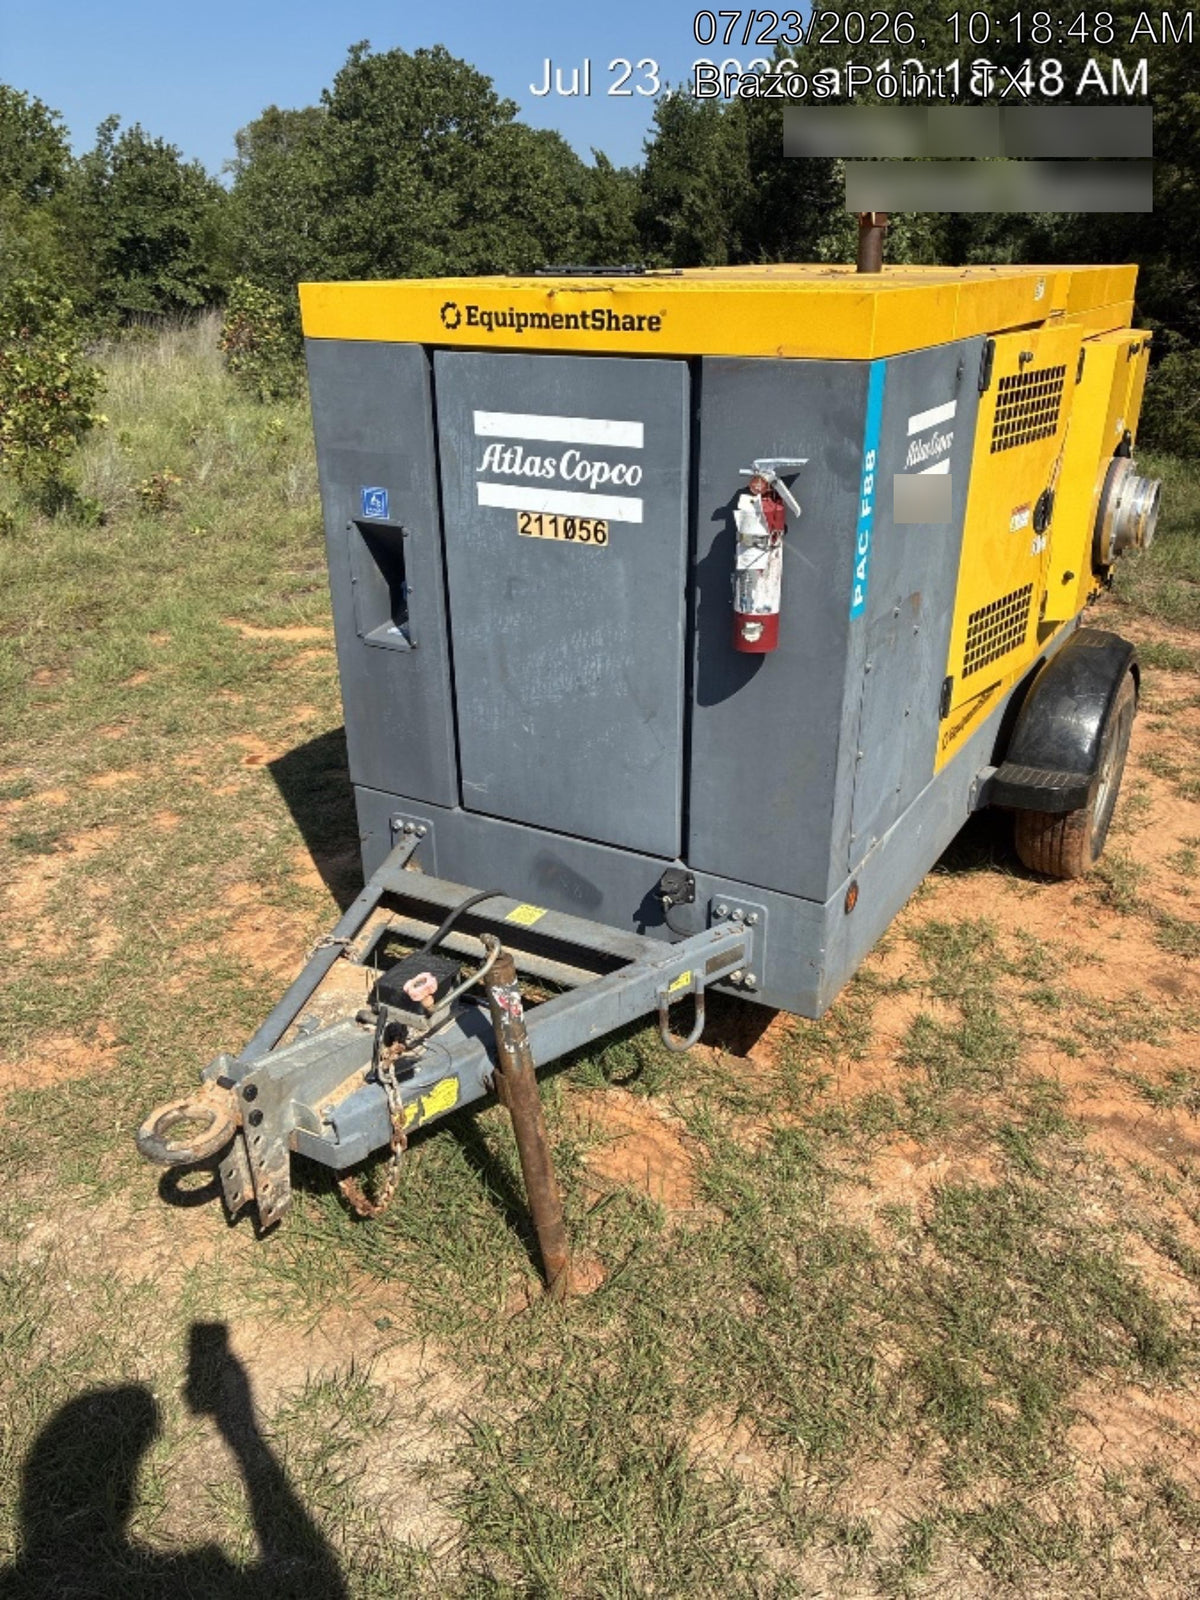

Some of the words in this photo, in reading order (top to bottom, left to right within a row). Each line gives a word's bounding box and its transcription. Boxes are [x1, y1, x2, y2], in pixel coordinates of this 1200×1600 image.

[465, 305, 662, 333] EquipmentShare
[476, 443, 556, 479] Atlas
[559, 449, 643, 490] Copco
[519, 512, 607, 545] 211056
[853, 529, 869, 607] PAC
